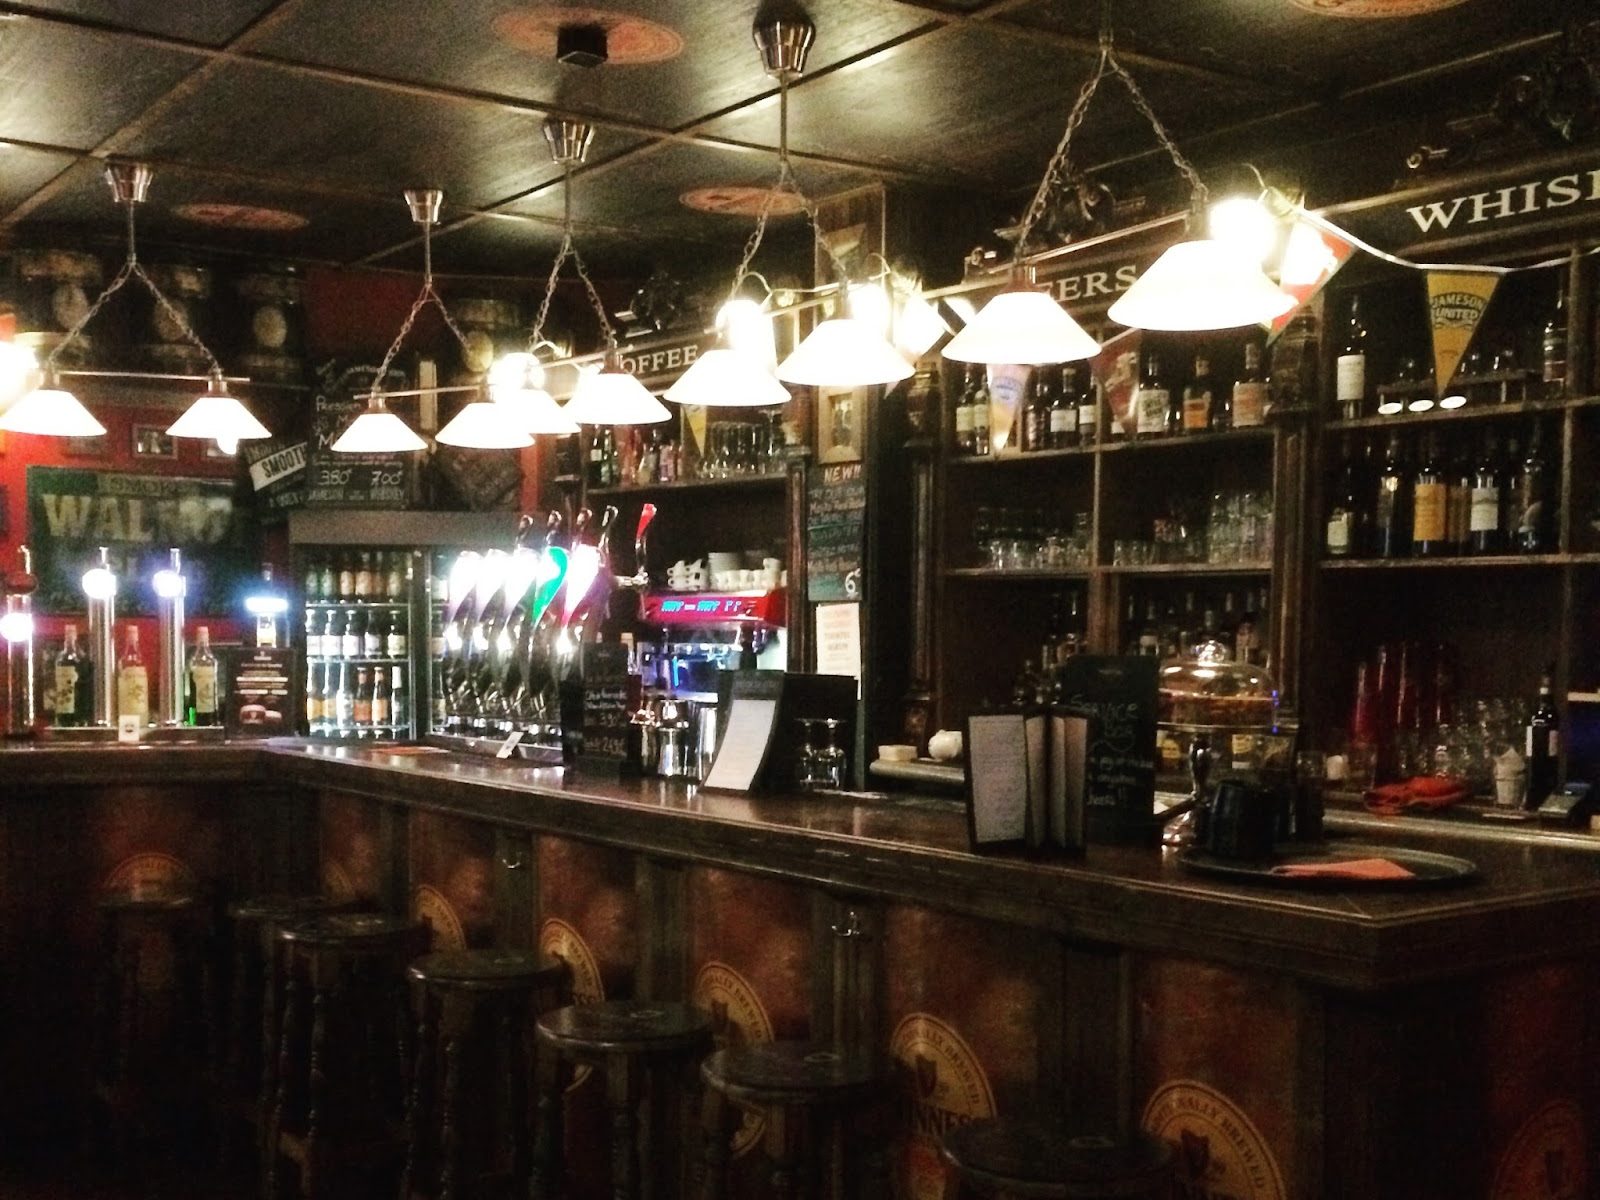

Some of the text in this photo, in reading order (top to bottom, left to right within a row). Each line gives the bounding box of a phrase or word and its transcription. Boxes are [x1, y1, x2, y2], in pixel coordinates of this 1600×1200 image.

[1040, 264, 1140, 301] ERS
[1431, 291, 1486, 310] JAMESON
[1434, 307, 1479, 320] UNITED
[621, 344, 699, 375] OFFEE
[1221, 1116, 1267, 1190] BREWED
